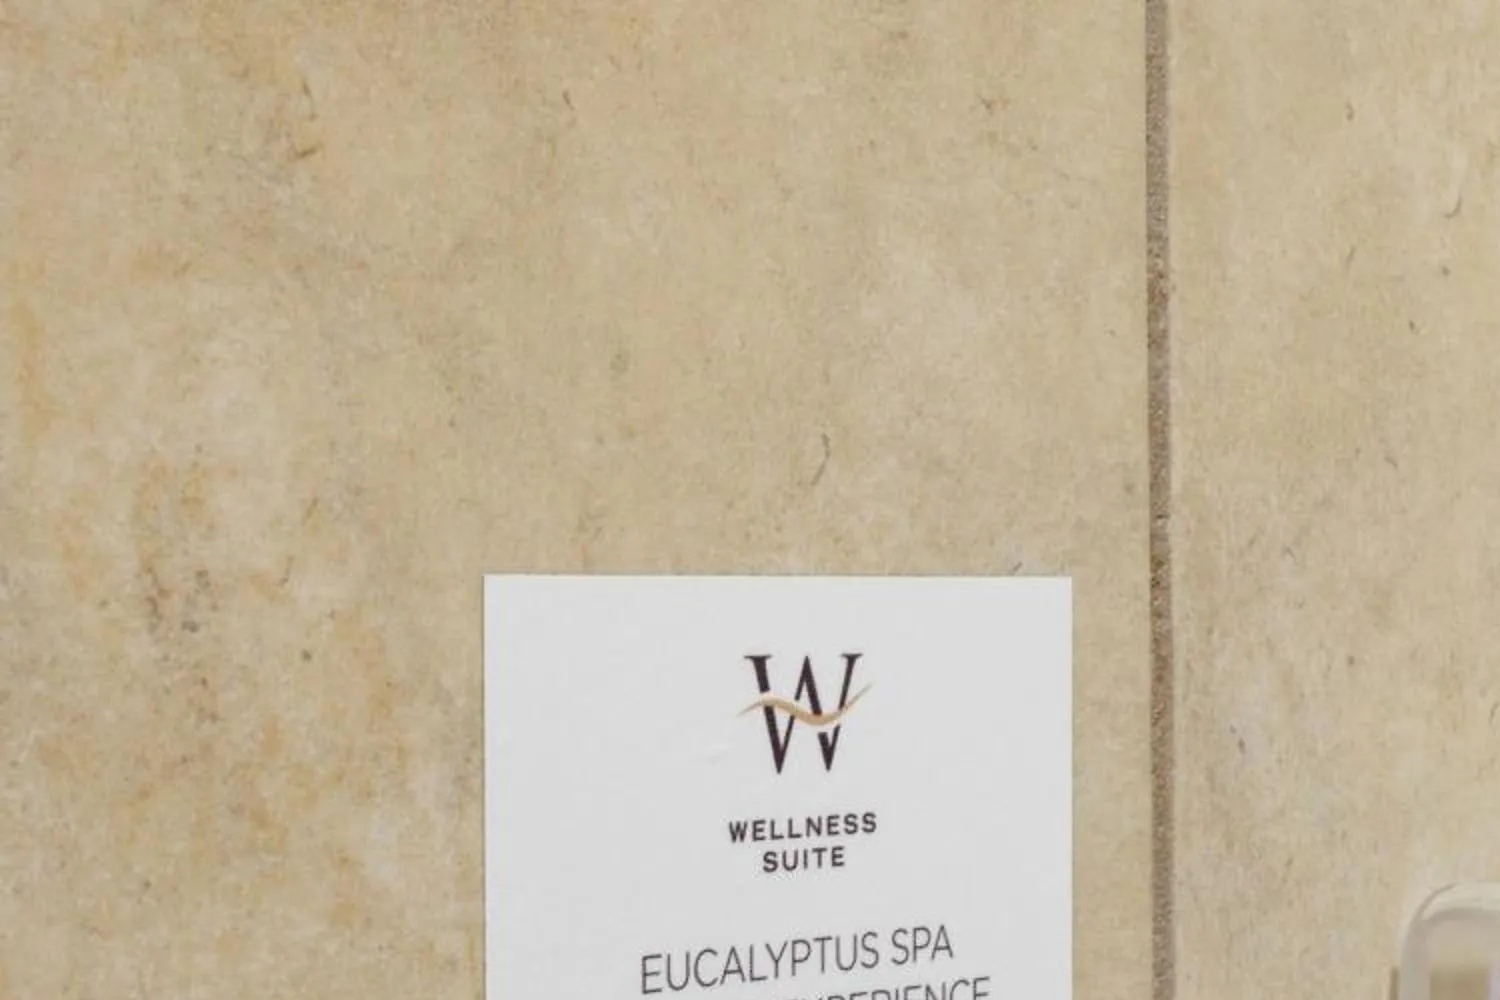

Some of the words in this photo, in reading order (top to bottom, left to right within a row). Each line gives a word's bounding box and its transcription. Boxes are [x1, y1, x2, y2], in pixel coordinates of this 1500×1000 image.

[744, 652, 864, 775] W
[727, 810, 878, 845] WELLNESS
[761, 844, 846, 875] SUITE
[640, 930, 880, 996] EUCALYPTUS
[890, 923, 955, 967] SPA
